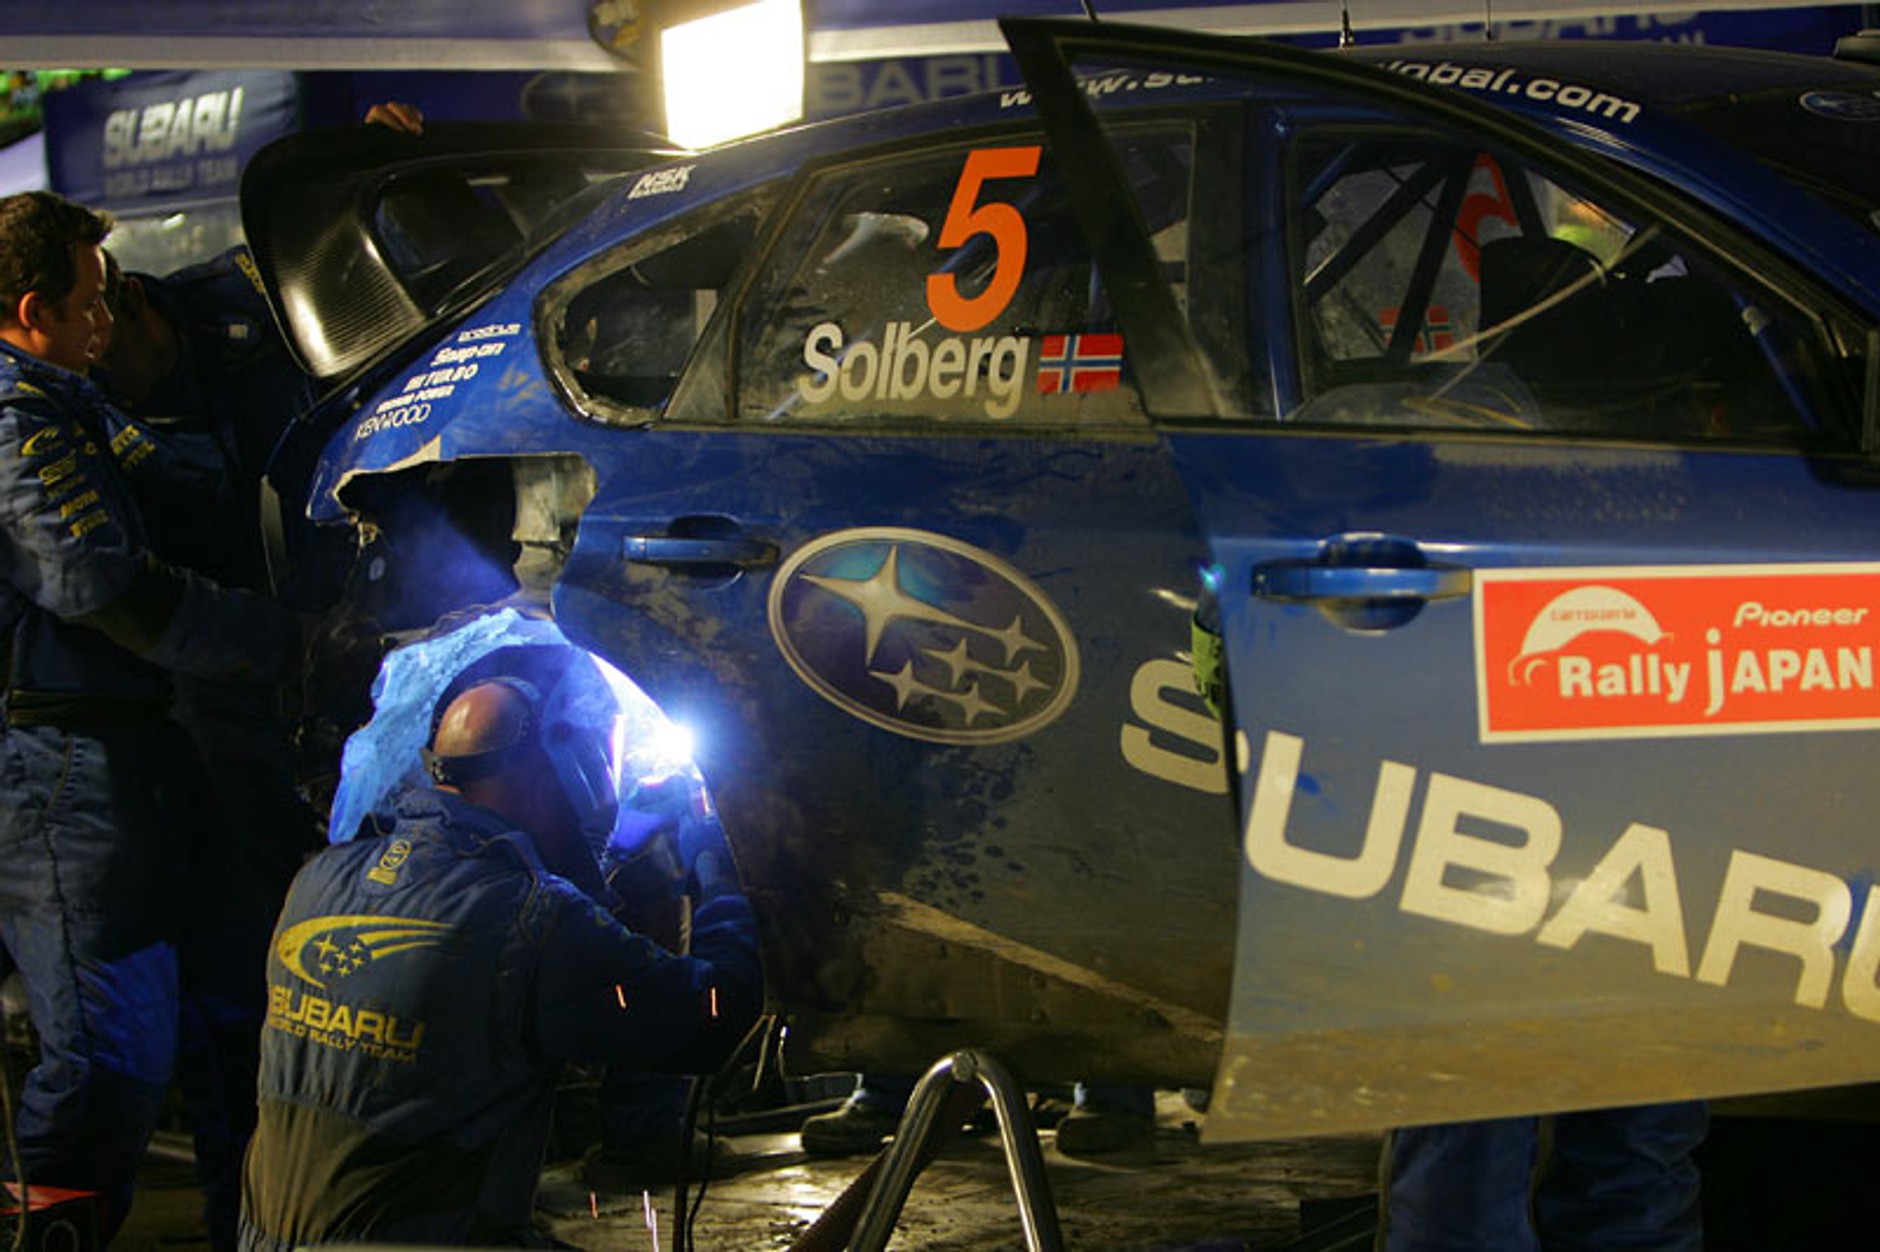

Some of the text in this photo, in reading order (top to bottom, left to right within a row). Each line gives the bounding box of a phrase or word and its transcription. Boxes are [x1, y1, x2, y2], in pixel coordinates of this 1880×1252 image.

[104, 86, 243, 169] SUBARU
[925, 146, 1043, 332] 5
[425, 363, 479, 386] TURBO
[800, 322, 1030, 420] Solberg
[354, 402, 431, 441] KENWOOD
[1733, 601, 1868, 628] Pioneer
[1558, 653, 1691, 703] Rally
[1120, 658, 1880, 1023] SUBAR
[268, 984, 425, 1048] SUBARU
[311, 1029, 356, 1049] RALLY
[361, 1042, 416, 1065] TEAM
